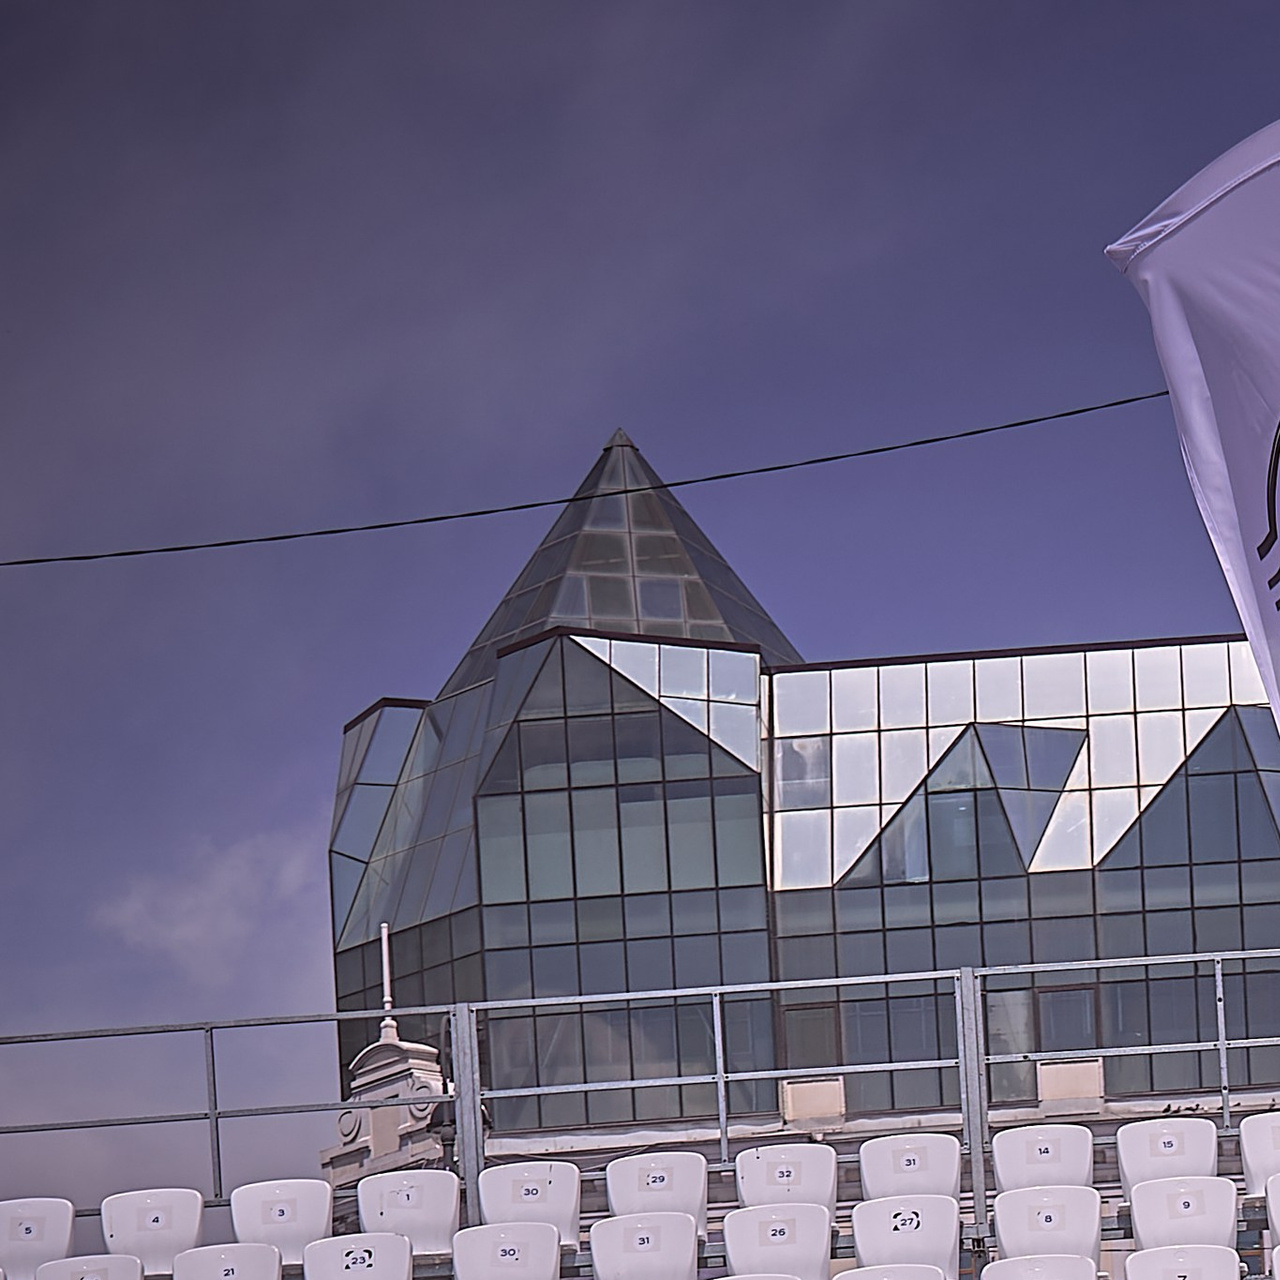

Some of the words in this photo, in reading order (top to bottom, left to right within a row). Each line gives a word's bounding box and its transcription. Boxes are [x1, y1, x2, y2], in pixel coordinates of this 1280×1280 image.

[1162, 1140, 1174, 1149] 15
[1038, 1147, 1050, 1155] 14
[905, 1158, 916, 1167] 31
[778, 1170, 792, 1179] 32
[651, 1175, 665, 1184] 29
[523, 1188, 539, 1196] 30
[900, 1217, 914, 1227] 27
[771, 1228, 786, 1237] 26
[638, 1236, 650, 1246] 31
[500, 1248, 516, 1257] 30
[351, 1256, 366, 1265] 23
[223, 1267, 235, 1277] 21
